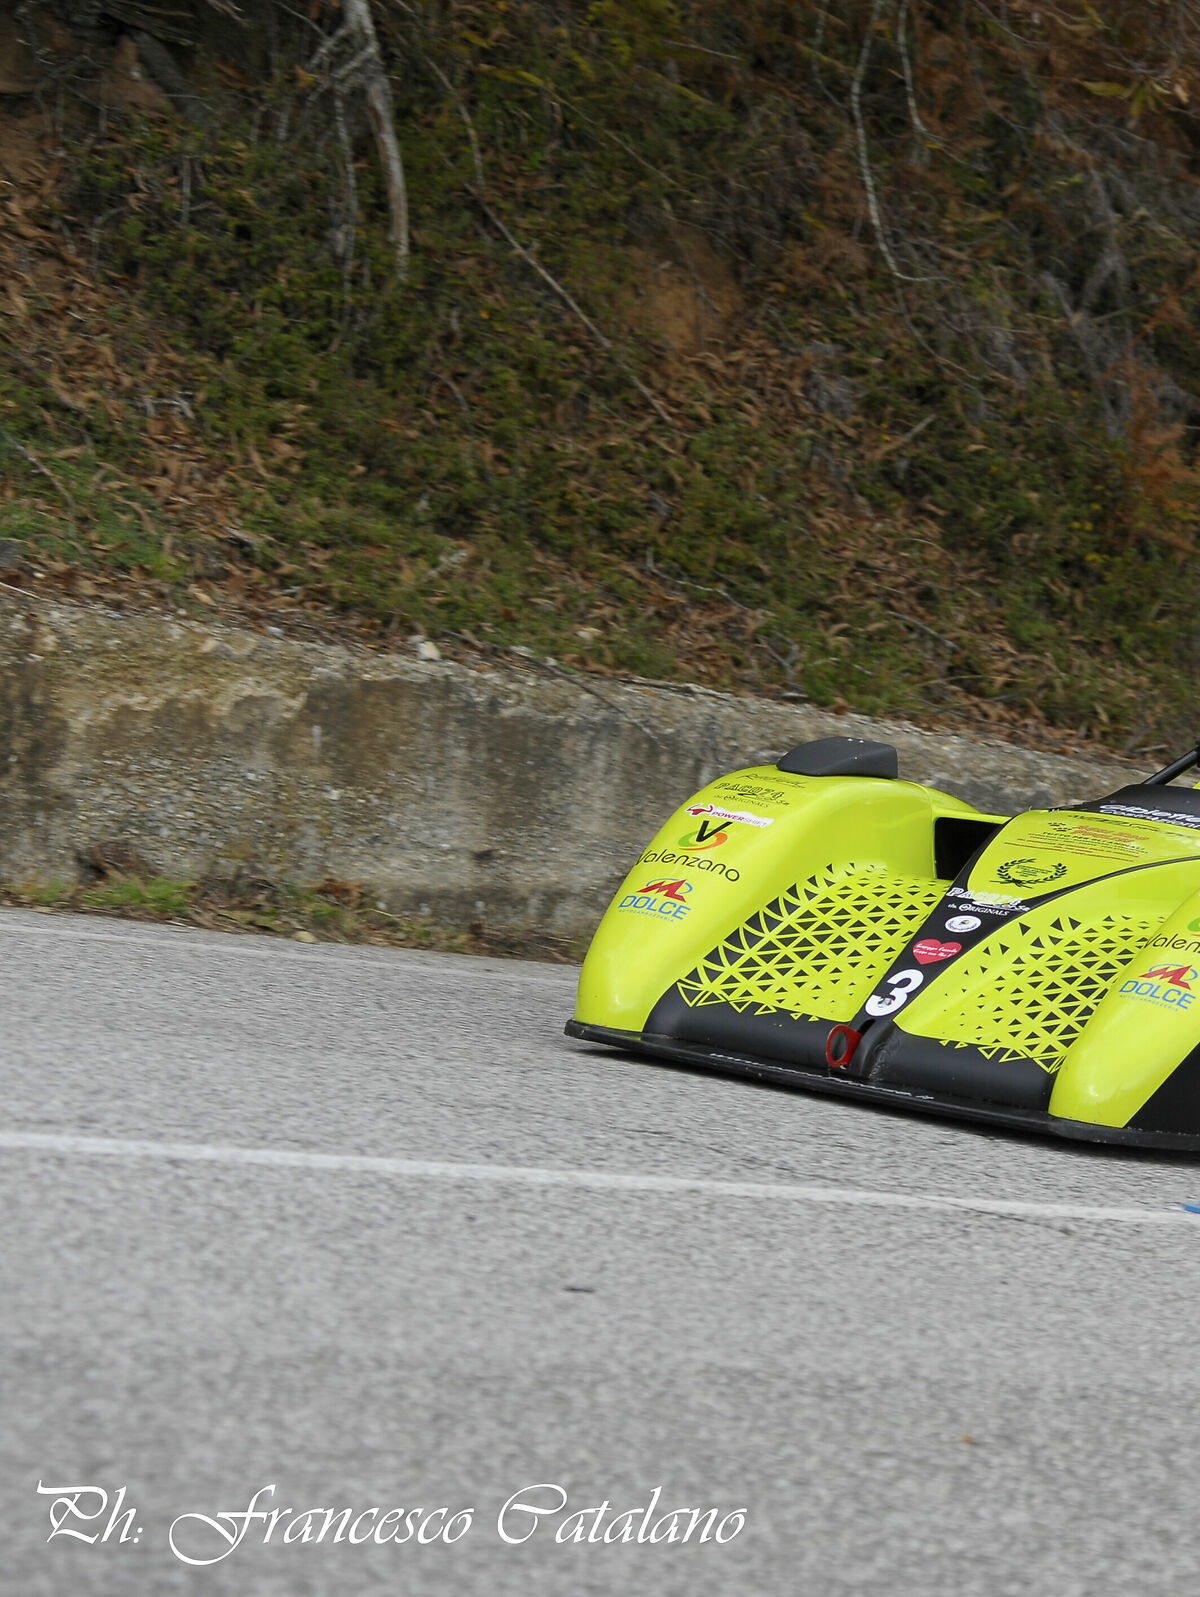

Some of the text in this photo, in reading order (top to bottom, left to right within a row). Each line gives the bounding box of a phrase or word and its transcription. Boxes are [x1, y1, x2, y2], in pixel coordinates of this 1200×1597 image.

[636, 849, 740, 882] Valenzano
[618, 895, 692, 920] DOLCE
[959, 903, 1010, 917] ORIGINALS
[865, 968, 924, 1017] 3
[1118, 980, 1197, 1010] DOLCE
